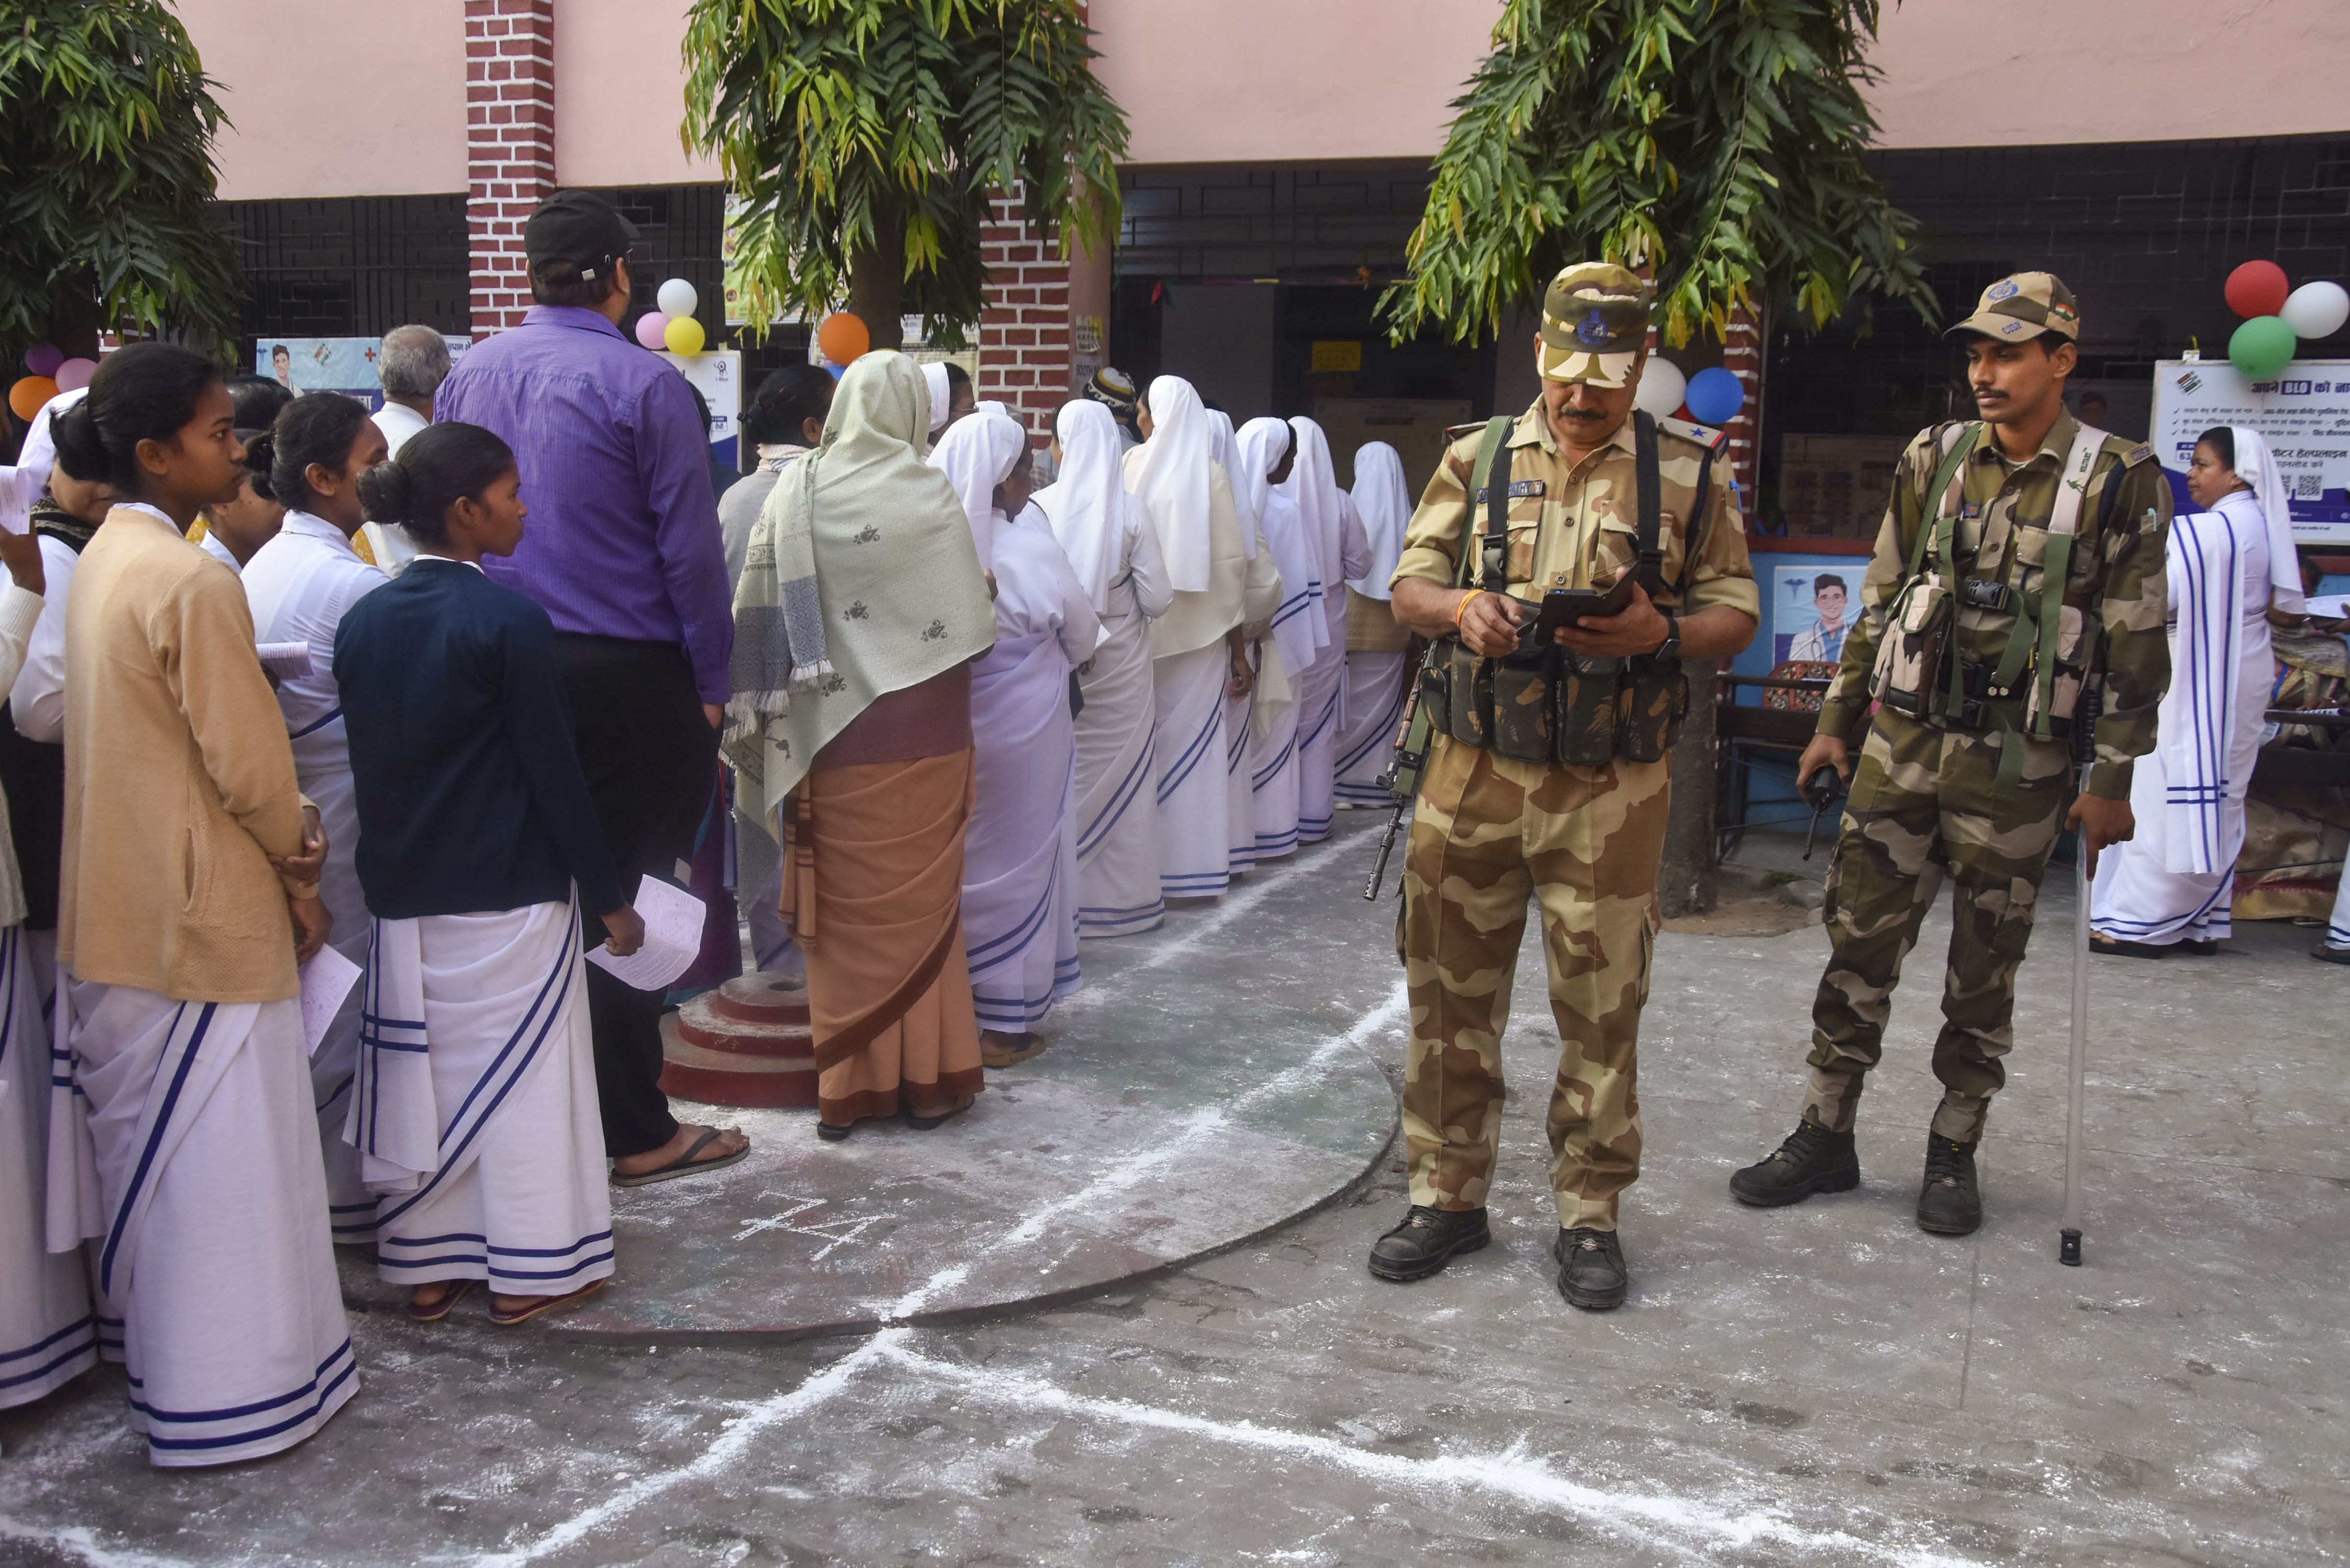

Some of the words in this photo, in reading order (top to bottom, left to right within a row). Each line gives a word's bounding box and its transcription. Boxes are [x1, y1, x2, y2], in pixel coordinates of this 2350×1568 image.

[1077, 364, 1093, 376] BOOTH
[2285, 382, 2308, 394] BLO
[2314, 380, 2331, 393] को
